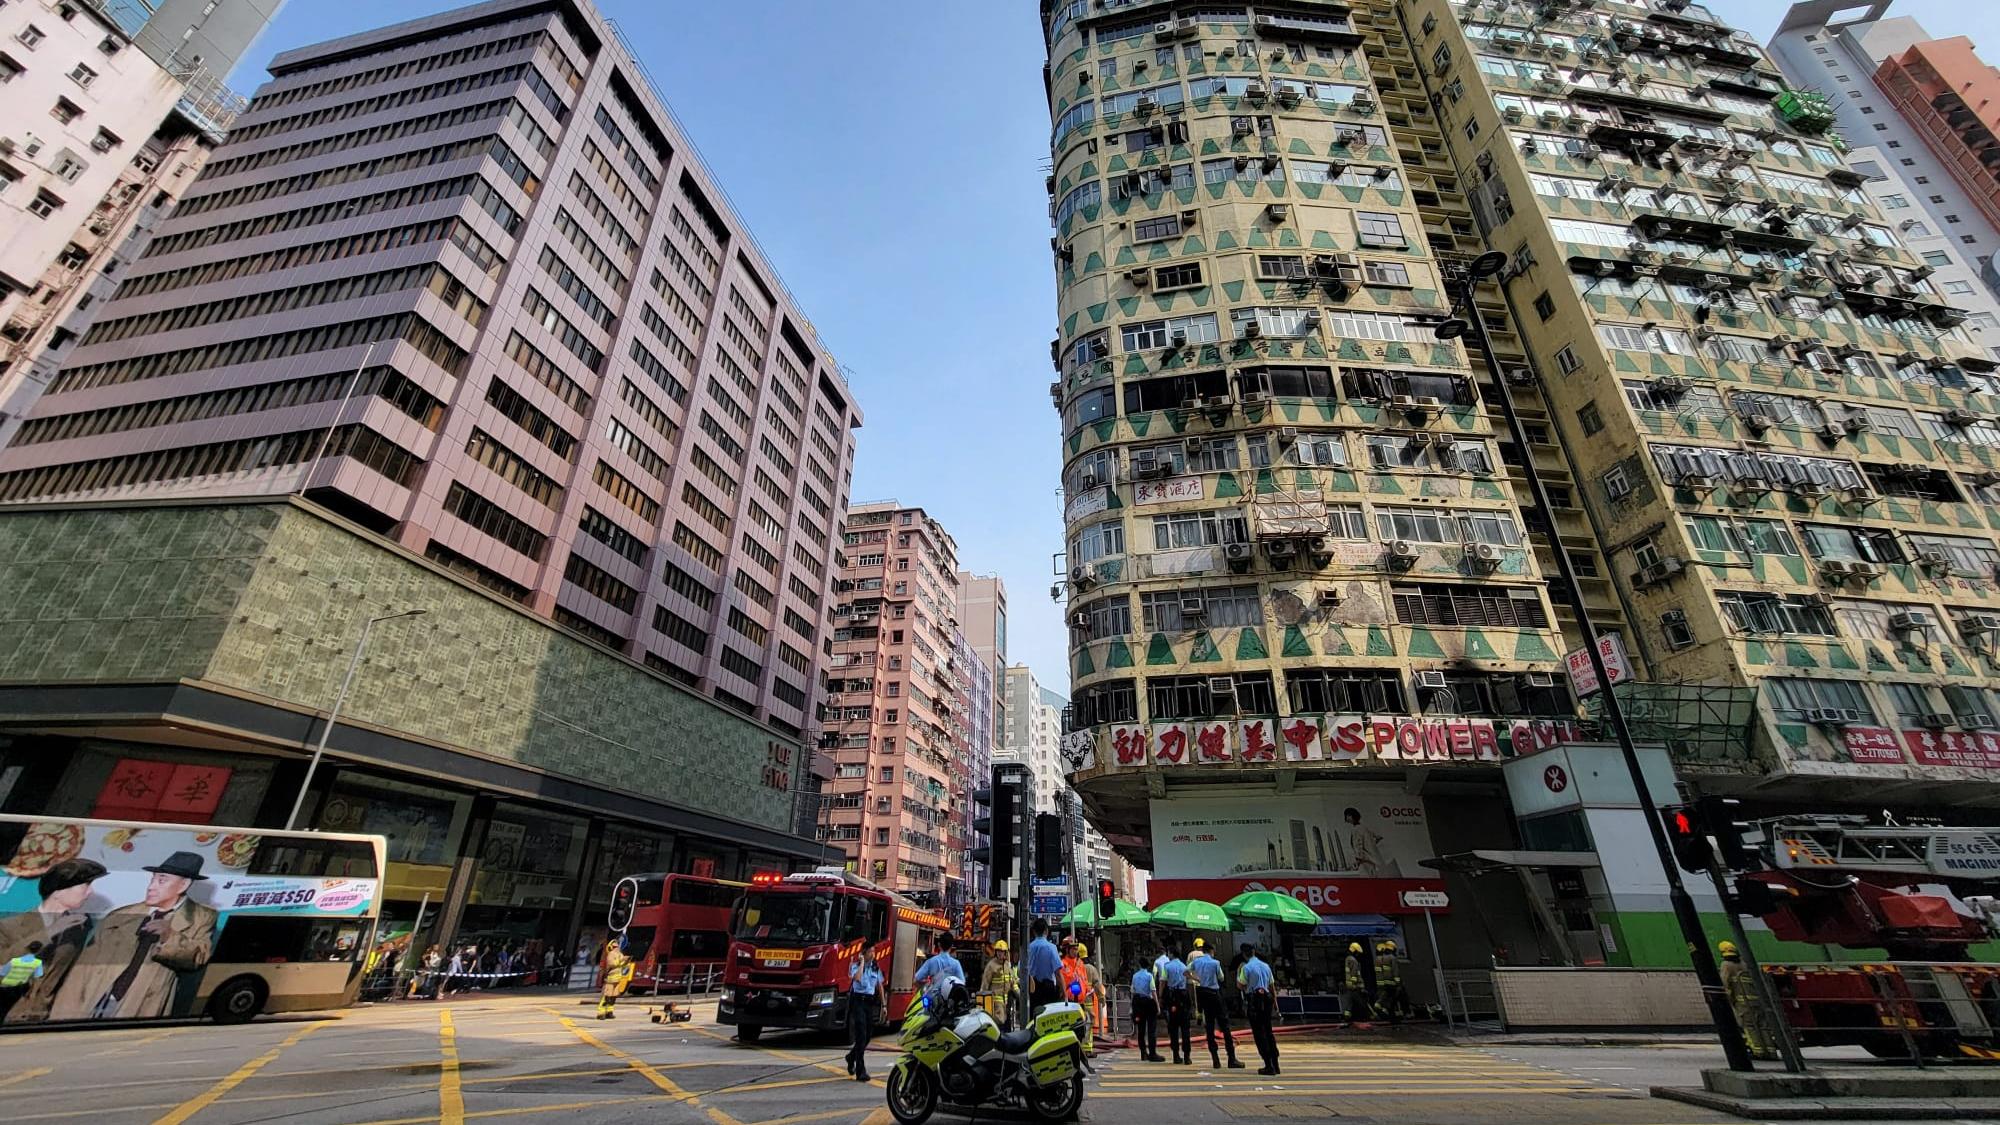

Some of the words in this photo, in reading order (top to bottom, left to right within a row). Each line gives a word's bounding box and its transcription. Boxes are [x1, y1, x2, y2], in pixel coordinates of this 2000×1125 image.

[1112, 720, 1366, 764] 動力健美中心
[1373, 721, 1500, 757] POWER
[1391, 807, 1422, 817] OCBC
[1950, 843, 1966, 854] 55
[1967, 843, 1985, 854] CS
